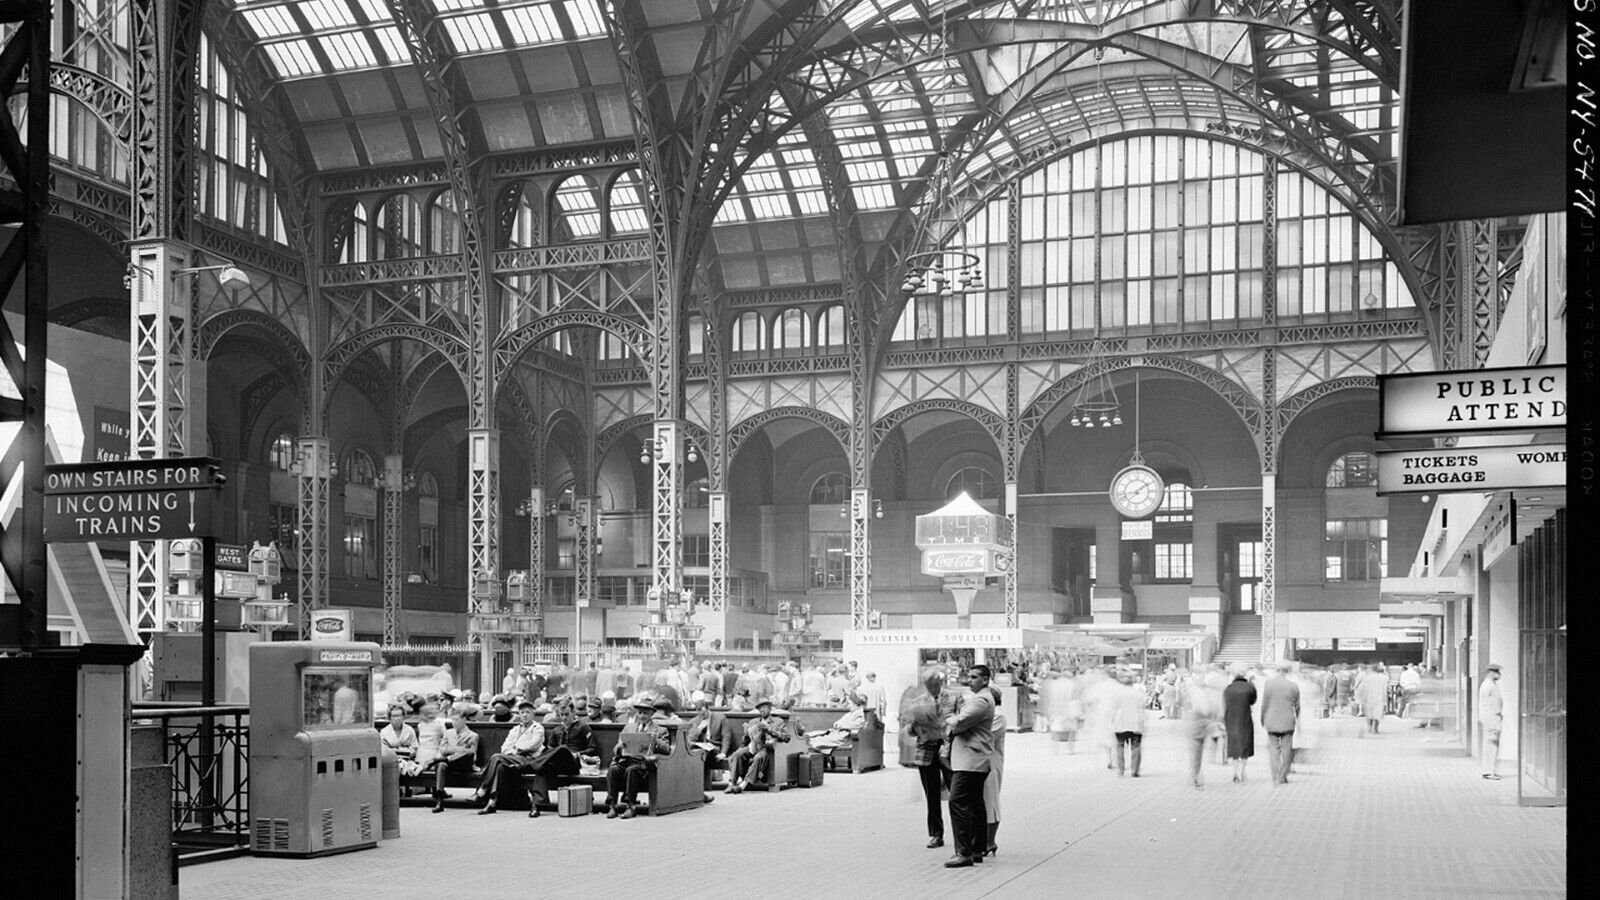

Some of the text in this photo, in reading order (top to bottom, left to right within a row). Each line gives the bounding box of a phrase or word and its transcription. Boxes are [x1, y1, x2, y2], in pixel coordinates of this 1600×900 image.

[1574, 21, 1596, 66] NO.
[1436, 376, 1556, 399] PUBLIC
[1447, 400, 1568, 421] ATTEND
[101, 422, 123, 436] While
[1402, 455, 1479, 469] TICKETS
[47, 467, 200, 490] OWN STAIRS FOR
[1402, 471, 1486, 485] BAGGAGE
[56, 492, 178, 514] INCOMING
[75, 515, 162, 535] TRAINS
[217, 555, 242, 564] GATES
[219, 547, 240, 557] WEST
